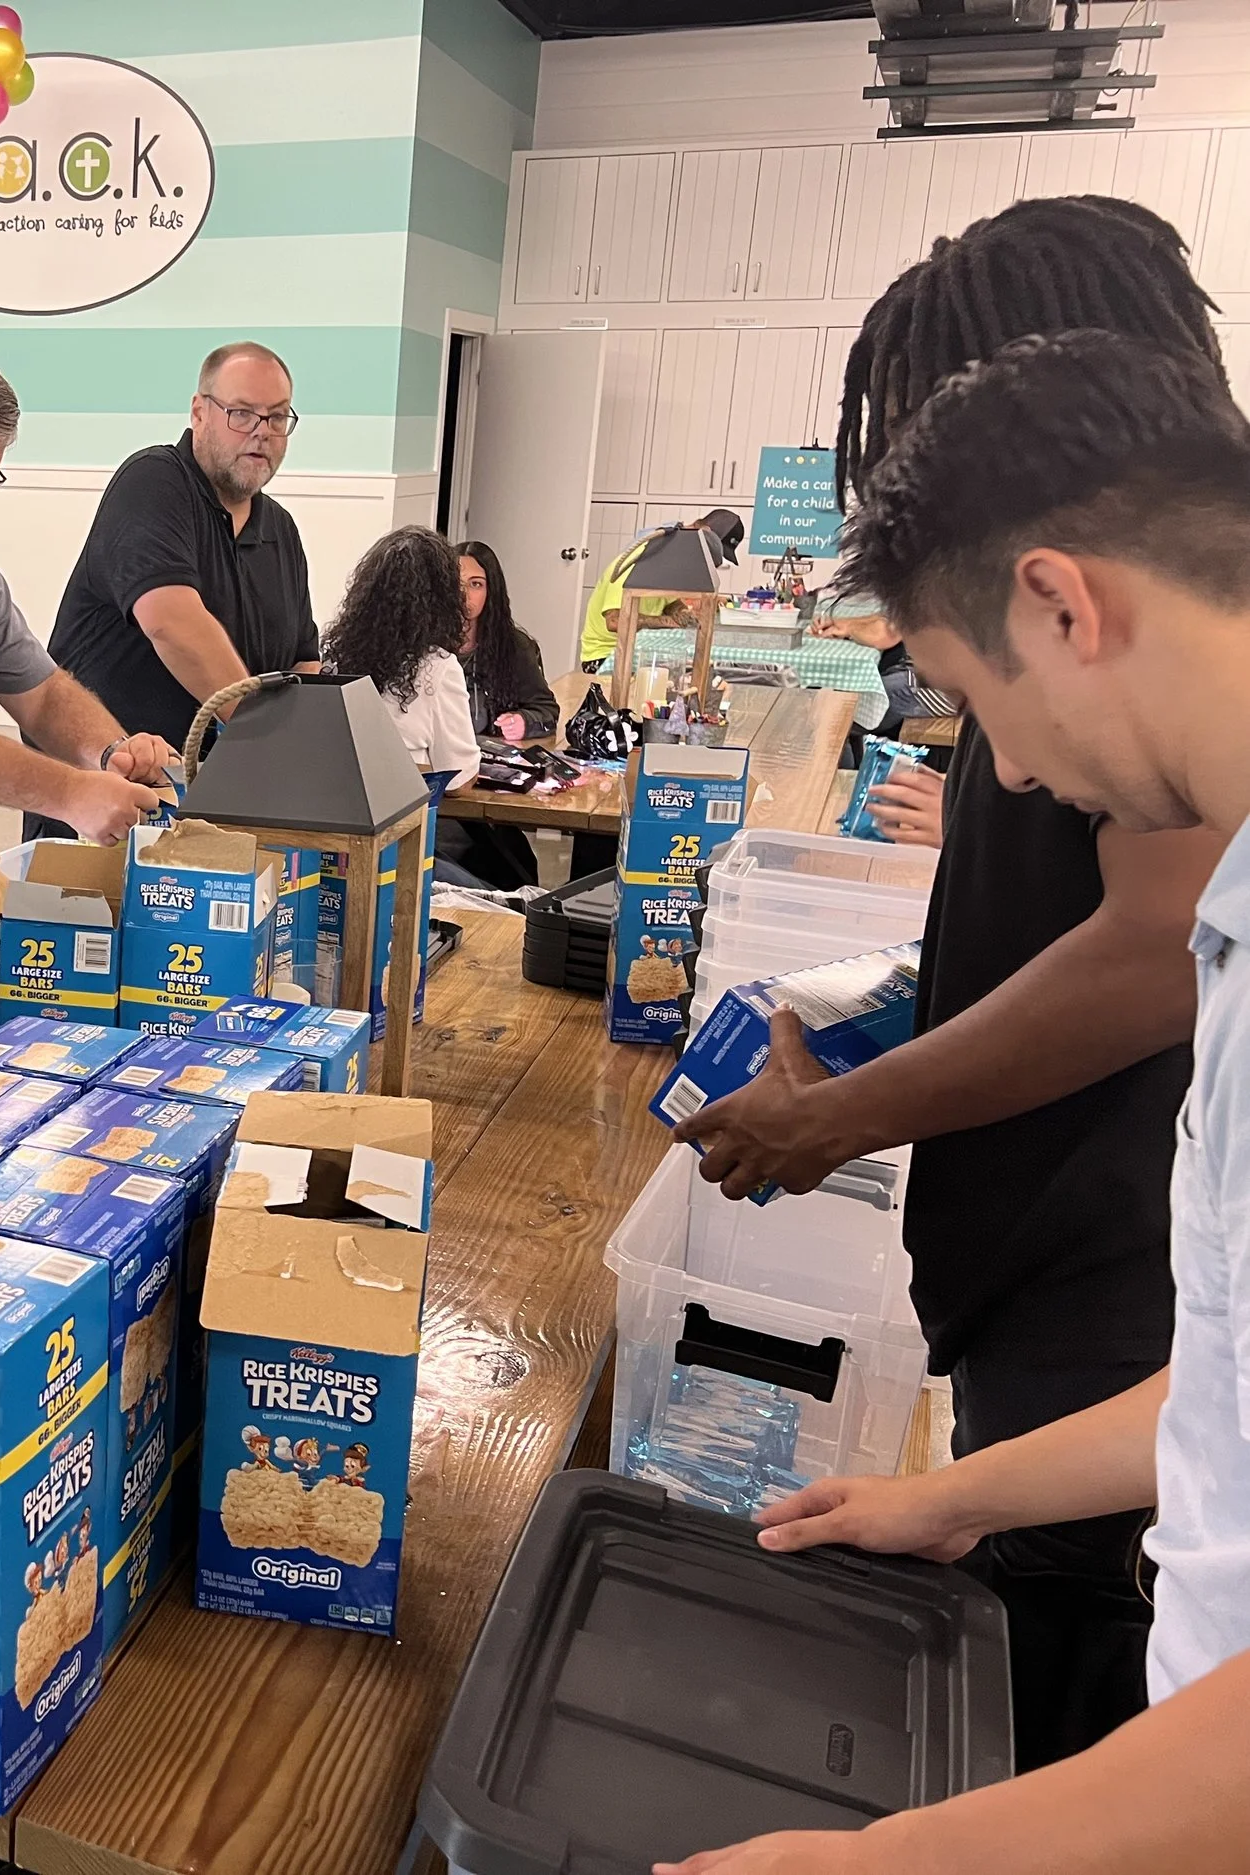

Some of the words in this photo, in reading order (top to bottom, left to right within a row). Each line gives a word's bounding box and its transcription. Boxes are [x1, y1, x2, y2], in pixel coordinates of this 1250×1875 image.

[55, 213, 104, 237] caring
[114, 209, 138, 235] for
[149, 204, 185, 229] kids
[763, 476, 798, 490] Make
[801, 480, 810, 490] a
[813, 481, 833, 490] car
[767, 495, 789, 508] for
[791, 499, 799, 508] a
[802, 496, 835, 509] child
[779, 514, 791, 527] in
[794, 517, 817, 527] our
[759, 534, 832, 550] community!
[647, 789, 664, 797] RICE
[664, 788, 696, 799] KRISPIES
[648, 796, 694, 809] TREATS
[669, 834, 701, 859] 25
[660, 857, 688, 866] LARGE
[667, 866, 697, 876] BARS
[140, 883, 159, 892] RICE
[159, 883, 196, 898] KRISPIES
[141, 892, 194, 910] TREATS
[318, 896, 341, 910] EATS
[642, 899, 666, 910] RICE
[667, 898, 699, 911] KRISP
[643, 909, 691, 925] TREA
[21, 939, 55, 969] 25
[168, 943, 204, 974] 25
[11, 966, 42, 978] LARGE
[42, 970, 63, 980] SIZE
[158, 971, 189, 983] LARGE
[189, 974, 211, 985] SIZE
[20, 977, 54, 990] BARS
[166, 981, 202, 996] BARS
[27, 991, 60, 1001] BIGGER
[174, 997, 208, 1008] BIGGER
[645, 1008, 682, 1022] Origin
[140, 1022, 168, 1035] RICE
[3, 1193, 47, 1228] TREATS
[45, 1316, 77, 1384] 25
[291, 1347, 335, 1366] Kellogg's
[37, 1374, 66, 1408] LARGE
[64, 1357, 83, 1384] SIZE
[243, 1359, 287, 1380] RICE
[289, 1362, 379, 1397] KRISPIES
[46, 1379, 77, 1420] BARS
[246, 1378, 373, 1424] TREATS
[53, 1397, 83, 1431] BIGGER
[123, 1421, 166, 1502] TREATS
[23, 1474, 51, 1517] RICE
[49, 1430, 96, 1486] KRISPIES
[24, 1453, 93, 1543] TREATS
[257, 1561, 336, 1587] Original
[37, 1656, 80, 1717] Original
